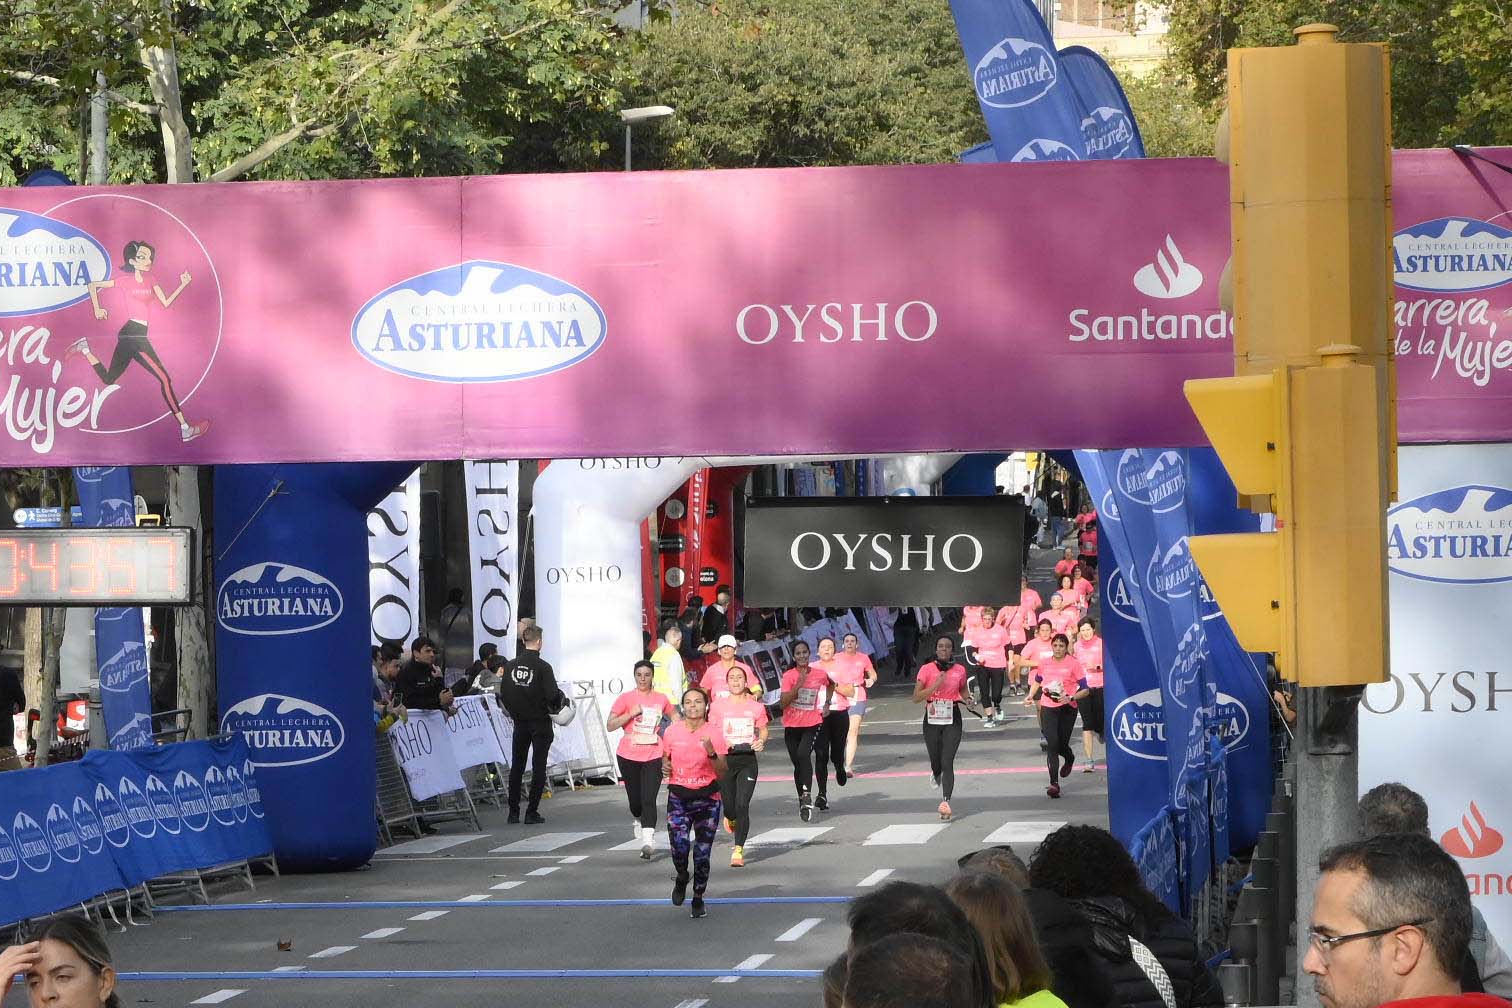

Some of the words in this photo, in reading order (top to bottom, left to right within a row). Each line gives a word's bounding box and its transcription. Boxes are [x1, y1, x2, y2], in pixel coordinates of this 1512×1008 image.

[12, 244, 86, 255] LECHERA
[1409, 243, 1458, 251] CENTRAL
[410, 304, 487, 317] CENTRAL
[495, 301, 578, 315] LECHERA
[1393, 298, 1489, 327] arrera
[372, 309, 587, 352] ASTURIANA
[735, 301, 938, 345] OYSHO
[1068, 308, 1234, 342] Santand
[1418, 327, 1436, 356] la
[1415, 520, 1482, 530] CENTRAL
[790, 531, 984, 573] OYSHO
[546, 565, 622, 585] OYSHO
[233, 588, 277, 596] CENTRAL
[280, 586, 329, 595] LECHERA
[221, 592, 334, 620] ASTURIANA
[577, 678, 624, 696] SHO
[281, 718, 330, 726] LECHERA
